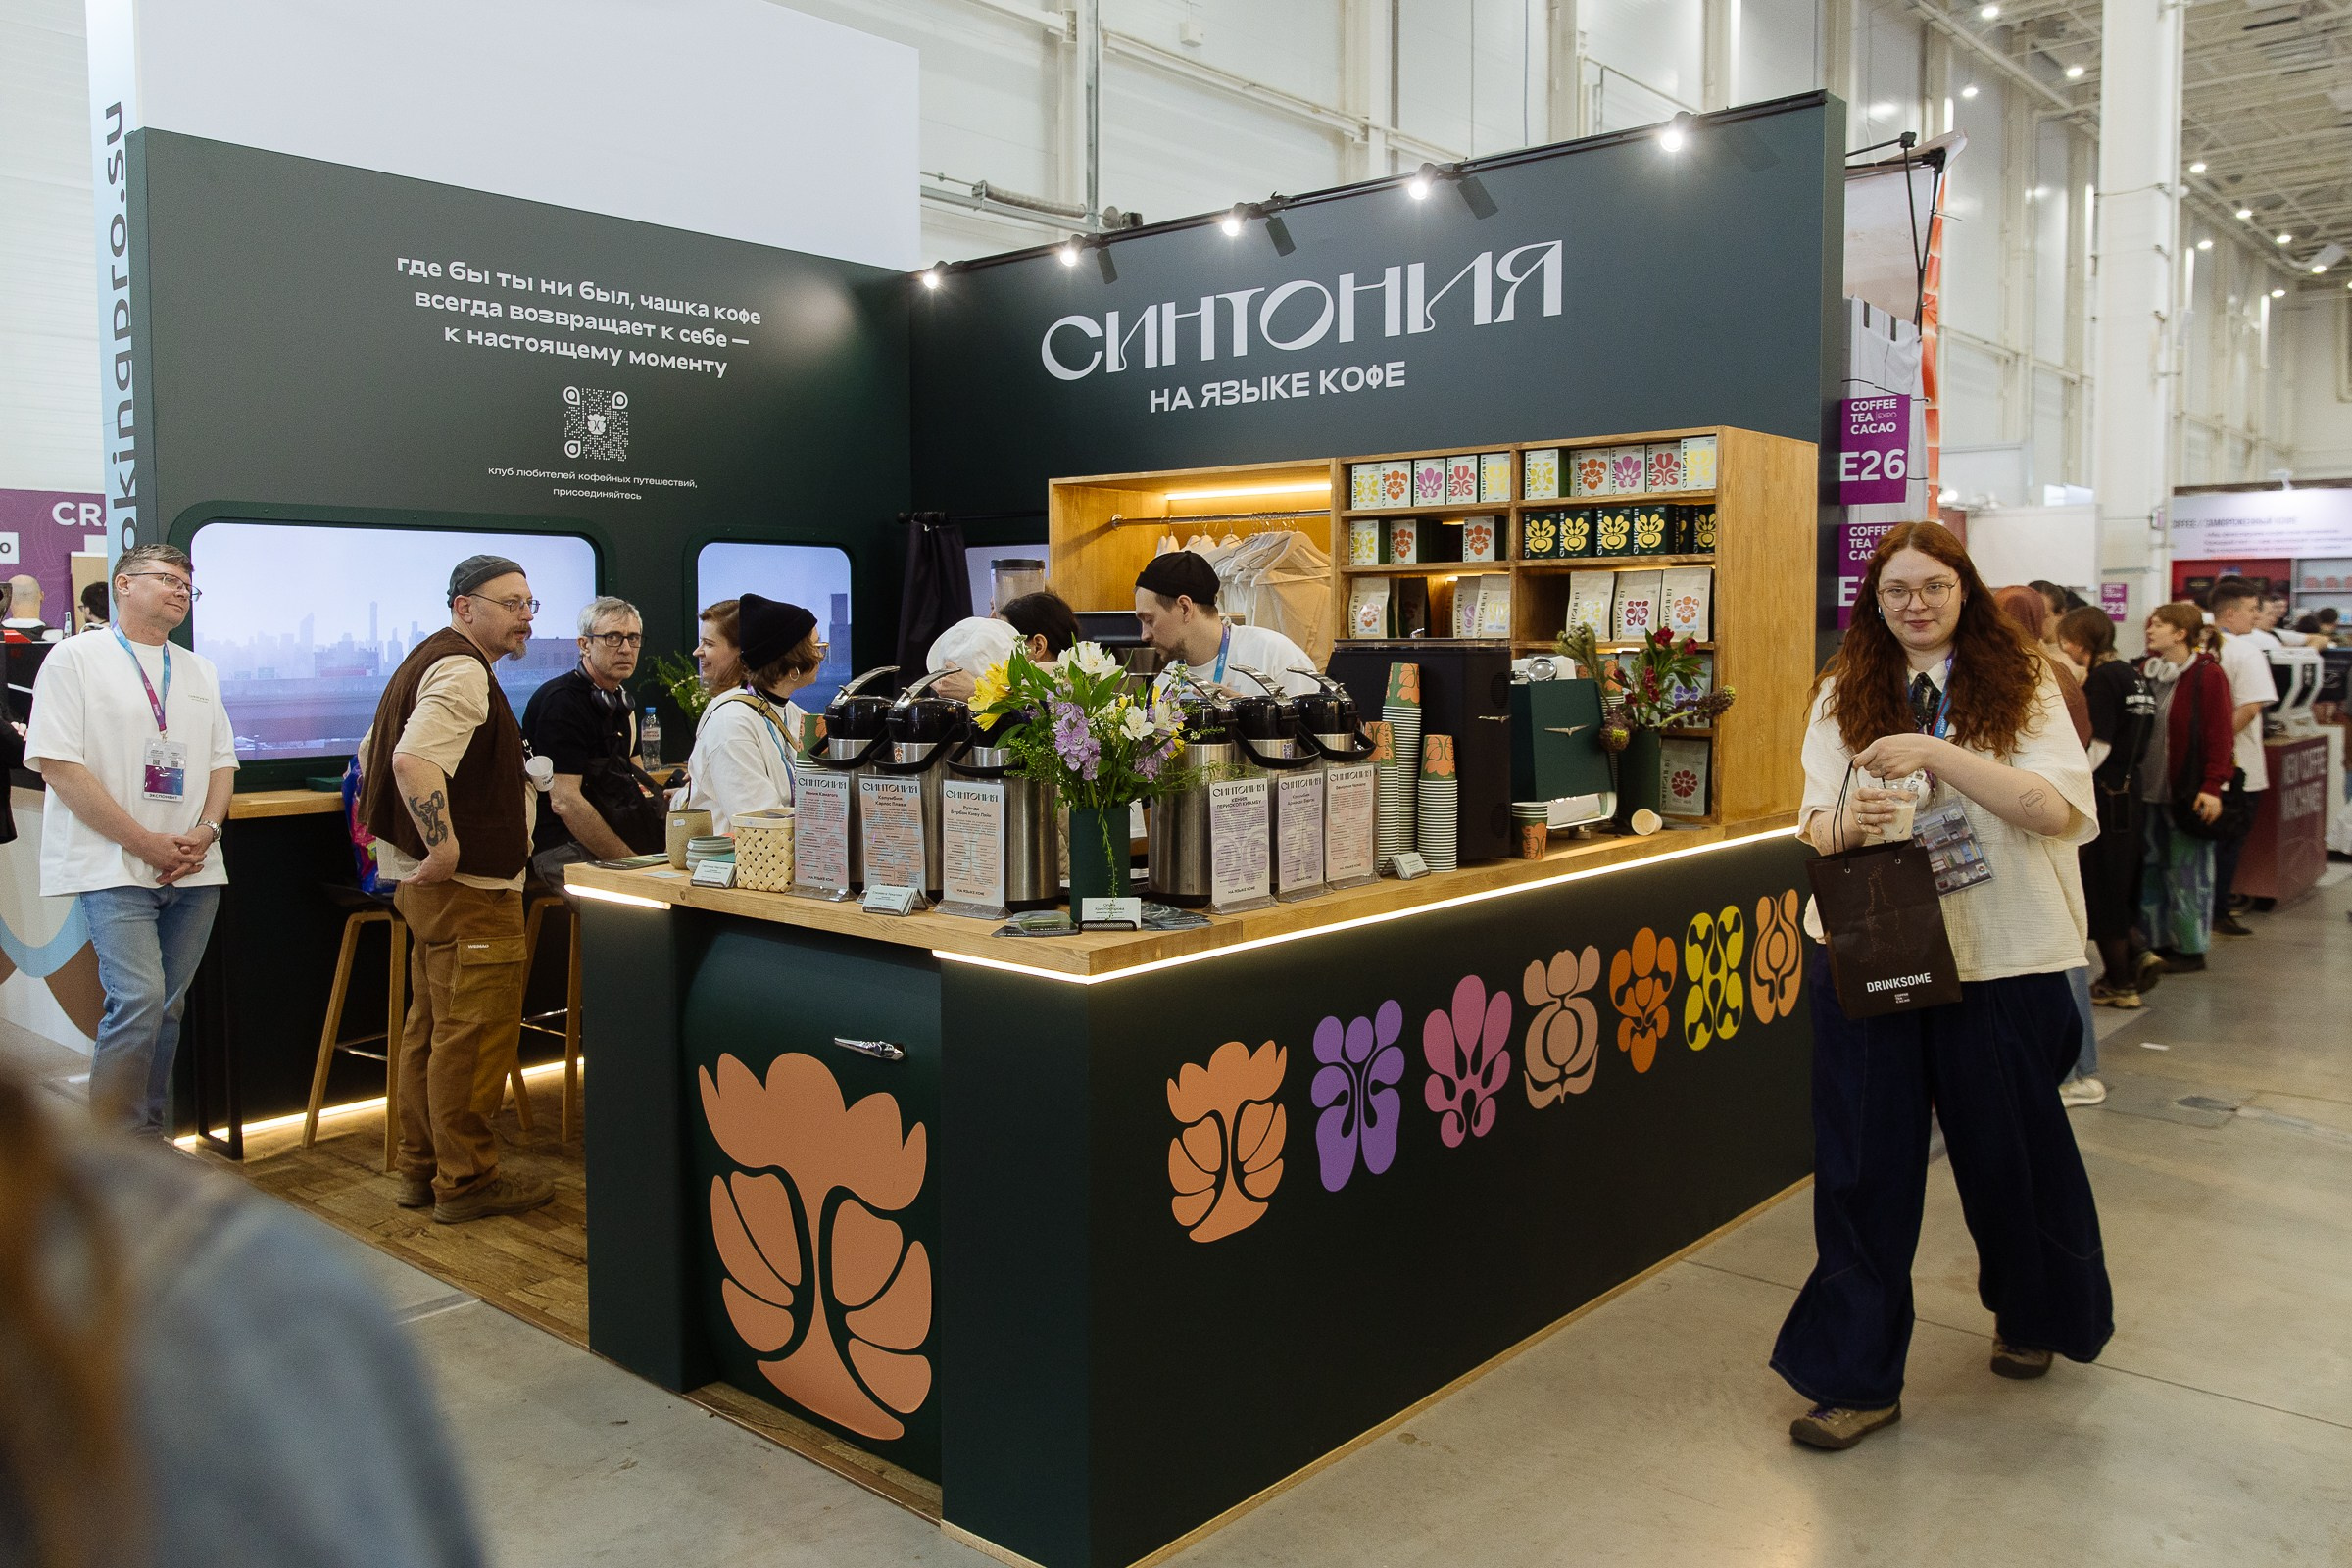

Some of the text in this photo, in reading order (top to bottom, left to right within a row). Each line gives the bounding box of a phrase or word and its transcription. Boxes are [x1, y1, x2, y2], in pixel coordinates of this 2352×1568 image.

[397, 257, 761, 326] где бы ты ни был, чашка кофе
[415, 291, 502, 318] всегда
[510, 305, 656, 338] возвращает
[662, 326, 674, 340] к
[679, 326, 727, 348] себе
[1042, 239, 1562, 381] СИНТОНИЯ
[106, 101, 137, 556] okingpro.su
[444, 327, 727, 379] к настоящему моменту
[1151, 360, 1405, 413] НА ЯЗЫКЕ КОФЕ
[1850, 398, 1897, 412] COFFEE
[1850, 413, 1874, 423] TEA
[1850, 421, 1897, 435] CACAO
[1839, 449, 1906, 482] E26
[488, 467, 698, 489] клуб любителей кофейных путешествий,
[553, 488, 642, 501] присоединяйтесь
[52, 502, 107, 526] CR
[1848, 538, 1872, 549] TEA
[1848, 550, 1875, 561] CAC
[1866, 972, 1933, 993] DRINKSOME
